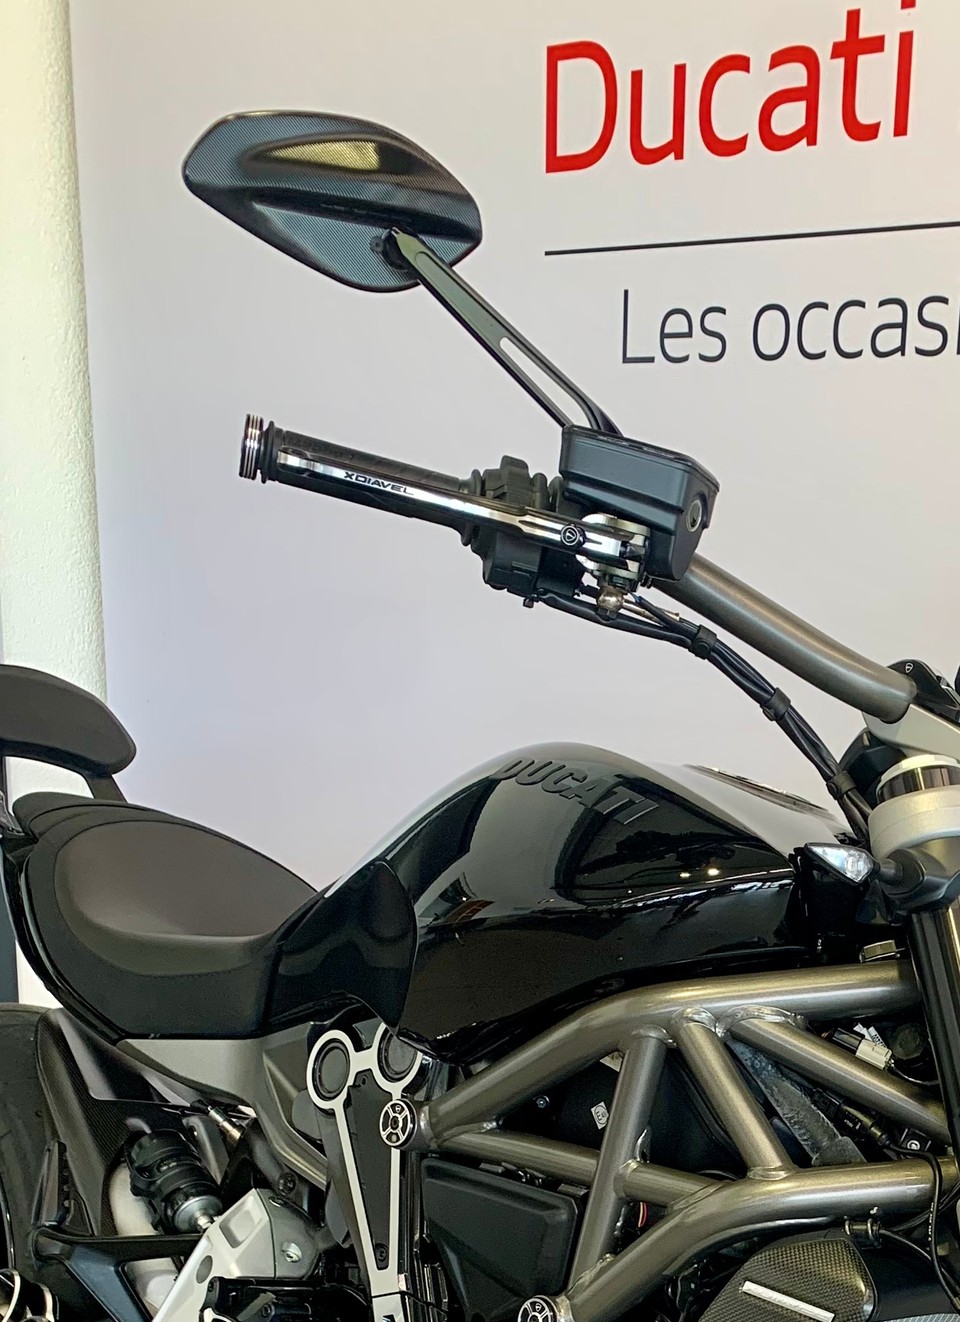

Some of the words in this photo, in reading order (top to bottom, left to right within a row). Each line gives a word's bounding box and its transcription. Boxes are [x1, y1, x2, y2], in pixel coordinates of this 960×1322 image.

[545, 0, 915, 173] Ducati
[621, 288, 727, 364] Les
[344, 471, 414, 496] XDIAVEL
[495, 756, 660, 826] DUCATI
